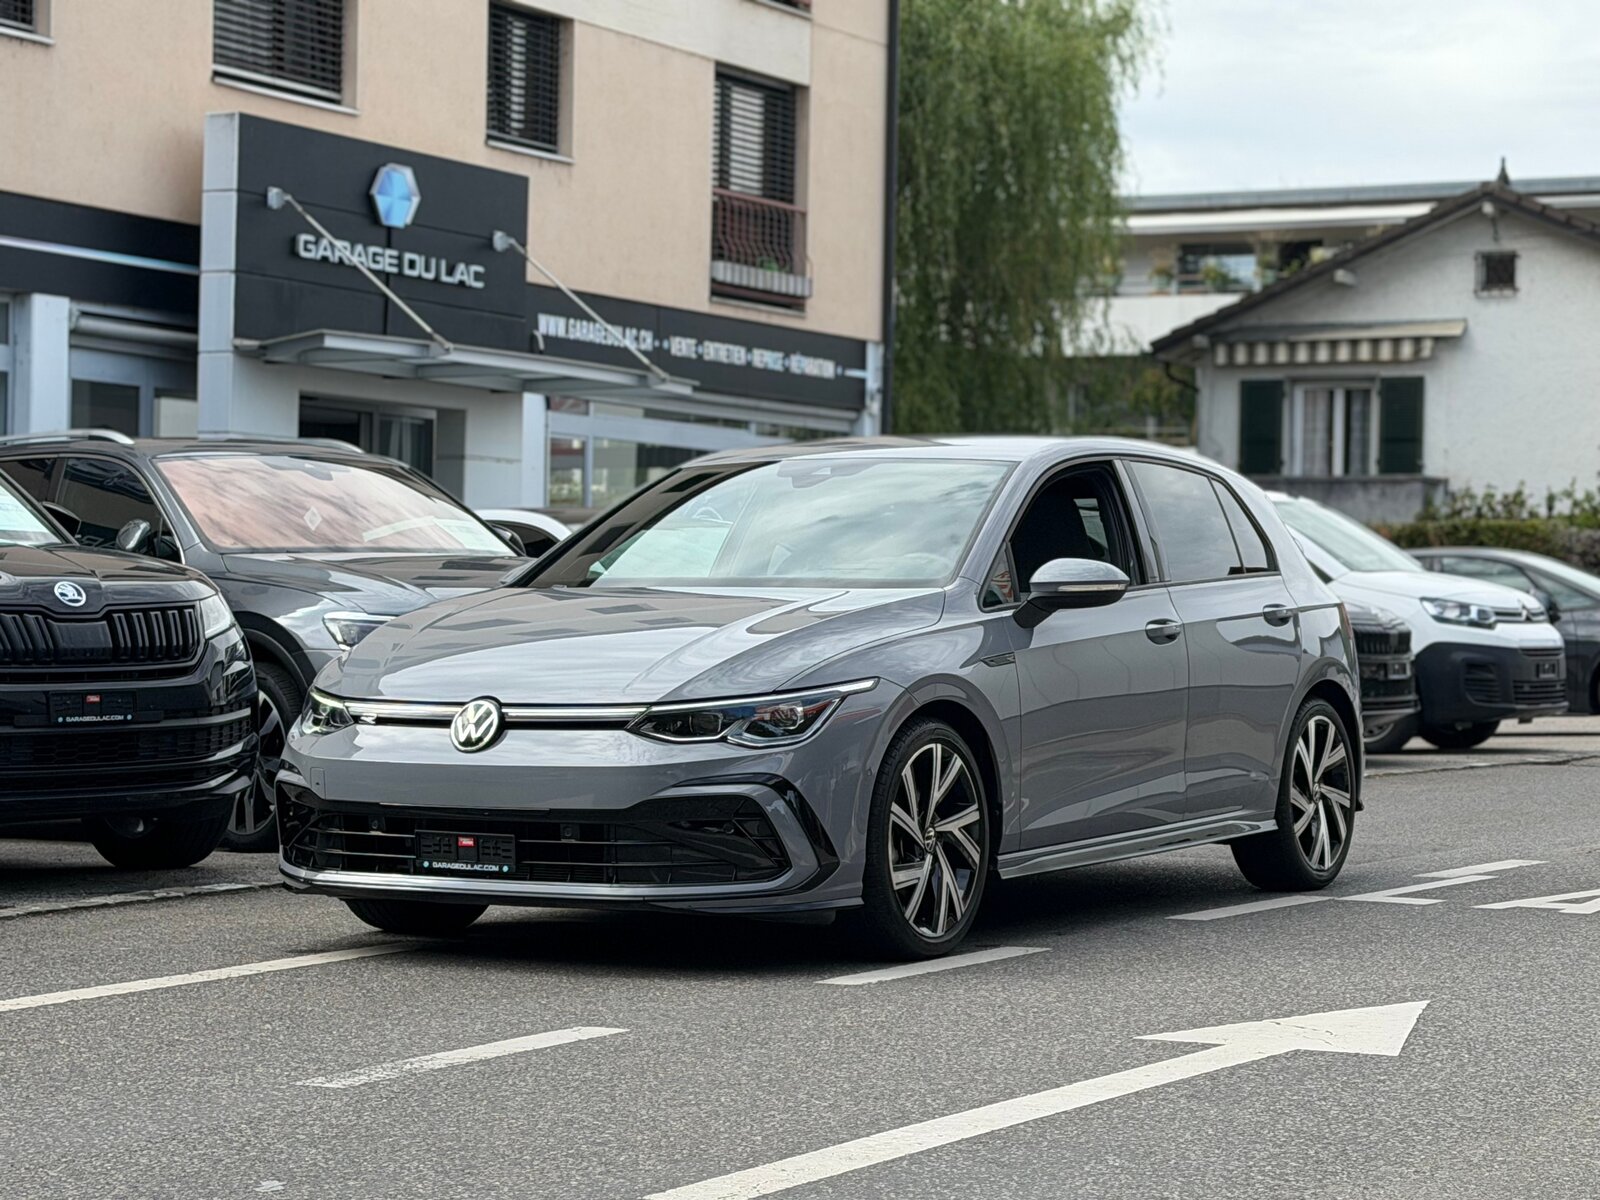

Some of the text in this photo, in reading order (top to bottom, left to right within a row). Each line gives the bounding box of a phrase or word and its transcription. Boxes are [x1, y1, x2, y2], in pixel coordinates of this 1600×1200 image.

[295, 233, 485, 289] GARAGE DU LAC
[432, 861, 500, 871] GARAGEDULAC.COM
